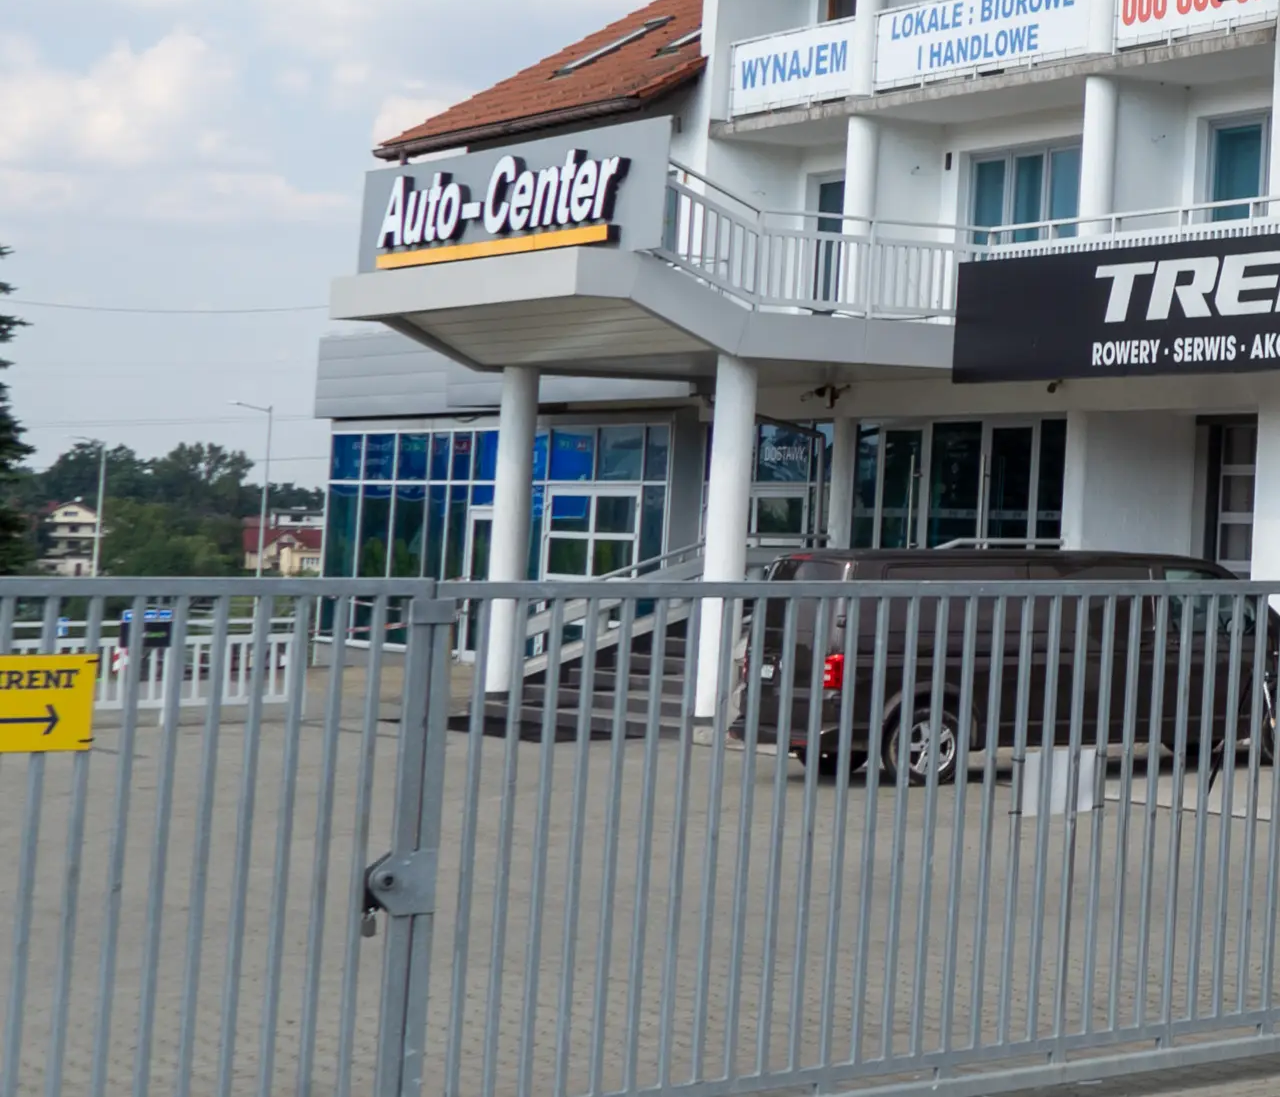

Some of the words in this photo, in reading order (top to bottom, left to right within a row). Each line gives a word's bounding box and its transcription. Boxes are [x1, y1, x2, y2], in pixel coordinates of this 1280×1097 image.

[891, 2, 963, 40] LOKALE
[742, 40, 848, 90] WYNAJEM
[929, 24, 1039, 68] HANDLOWE
[377, 148, 622, 248] Auto-Center
[1092, 339, 1160, 366] ROWERY
[1173, 335, 1237, 362] SERWIS
